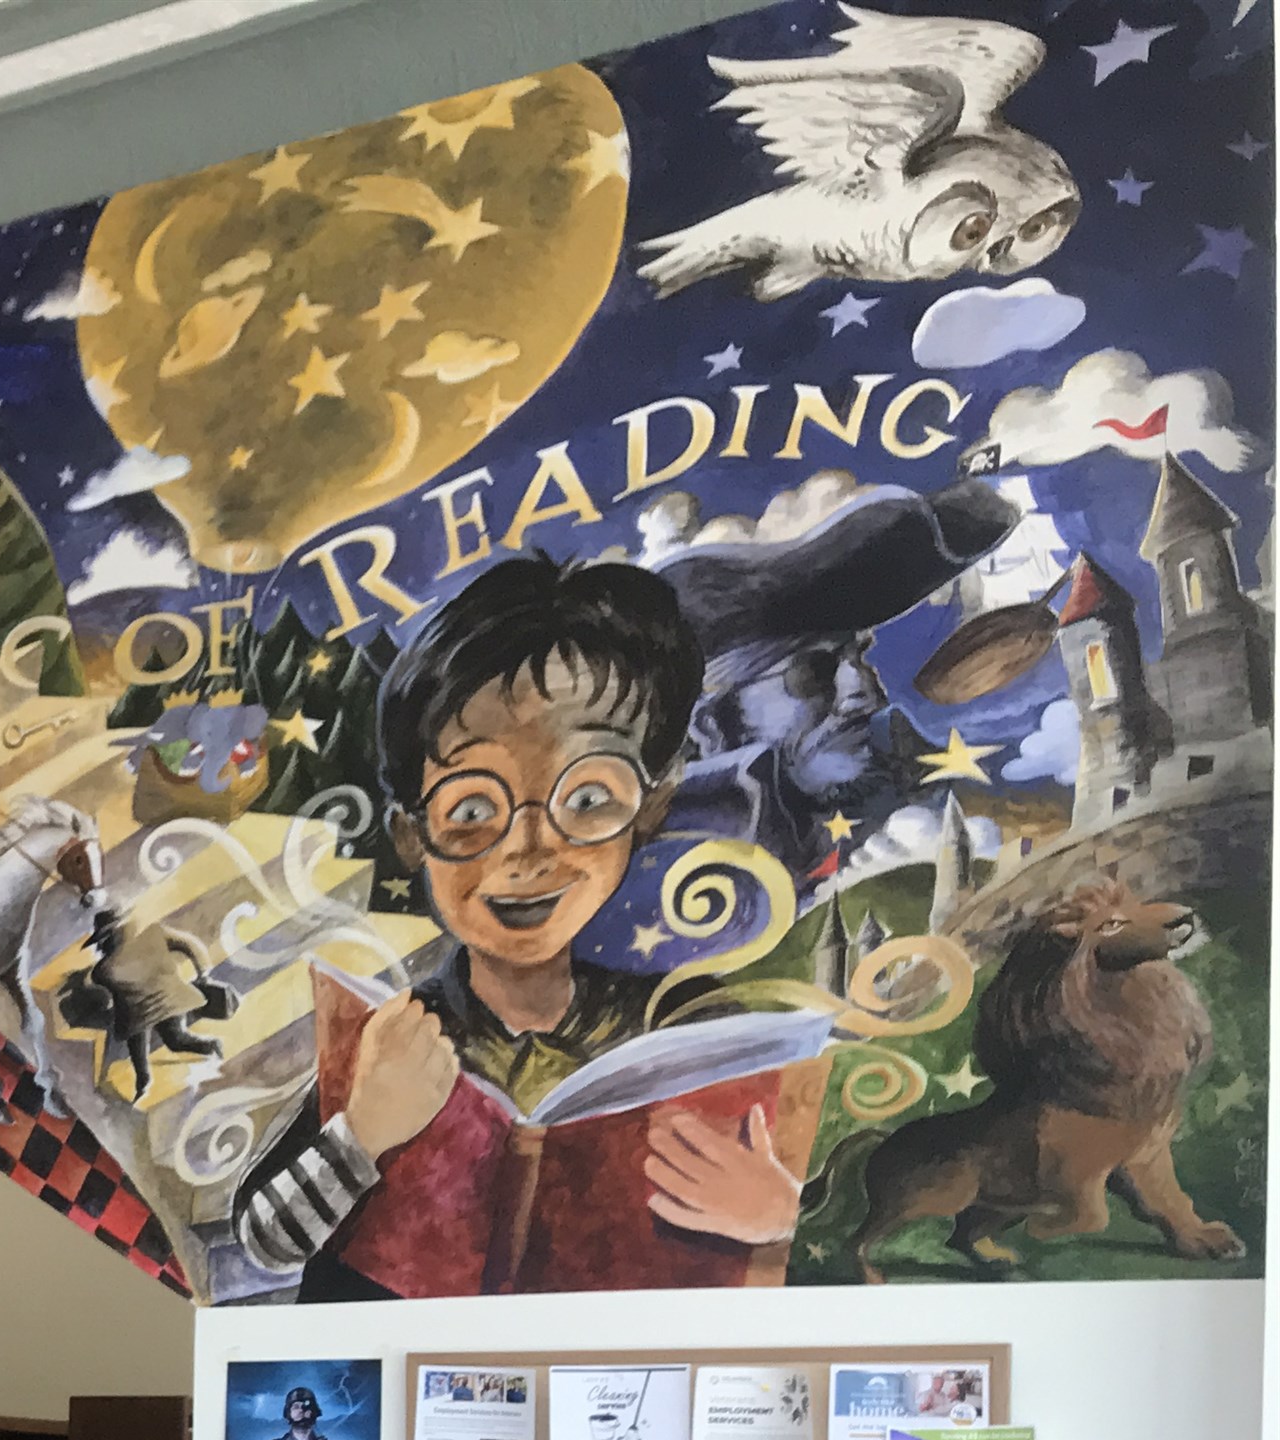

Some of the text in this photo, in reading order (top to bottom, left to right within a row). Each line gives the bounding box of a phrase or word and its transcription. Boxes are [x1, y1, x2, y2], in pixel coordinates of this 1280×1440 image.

[113, 585, 256, 686] OF
[298, 373, 973, 641] READING
[587, 1384, 639, 1406] Cleaning
[433, 1406, 469, 1416] Employment
[708, 1406, 775, 1416] EMPLOYMENT
[707, 1416, 755, 1425] SERVICES
